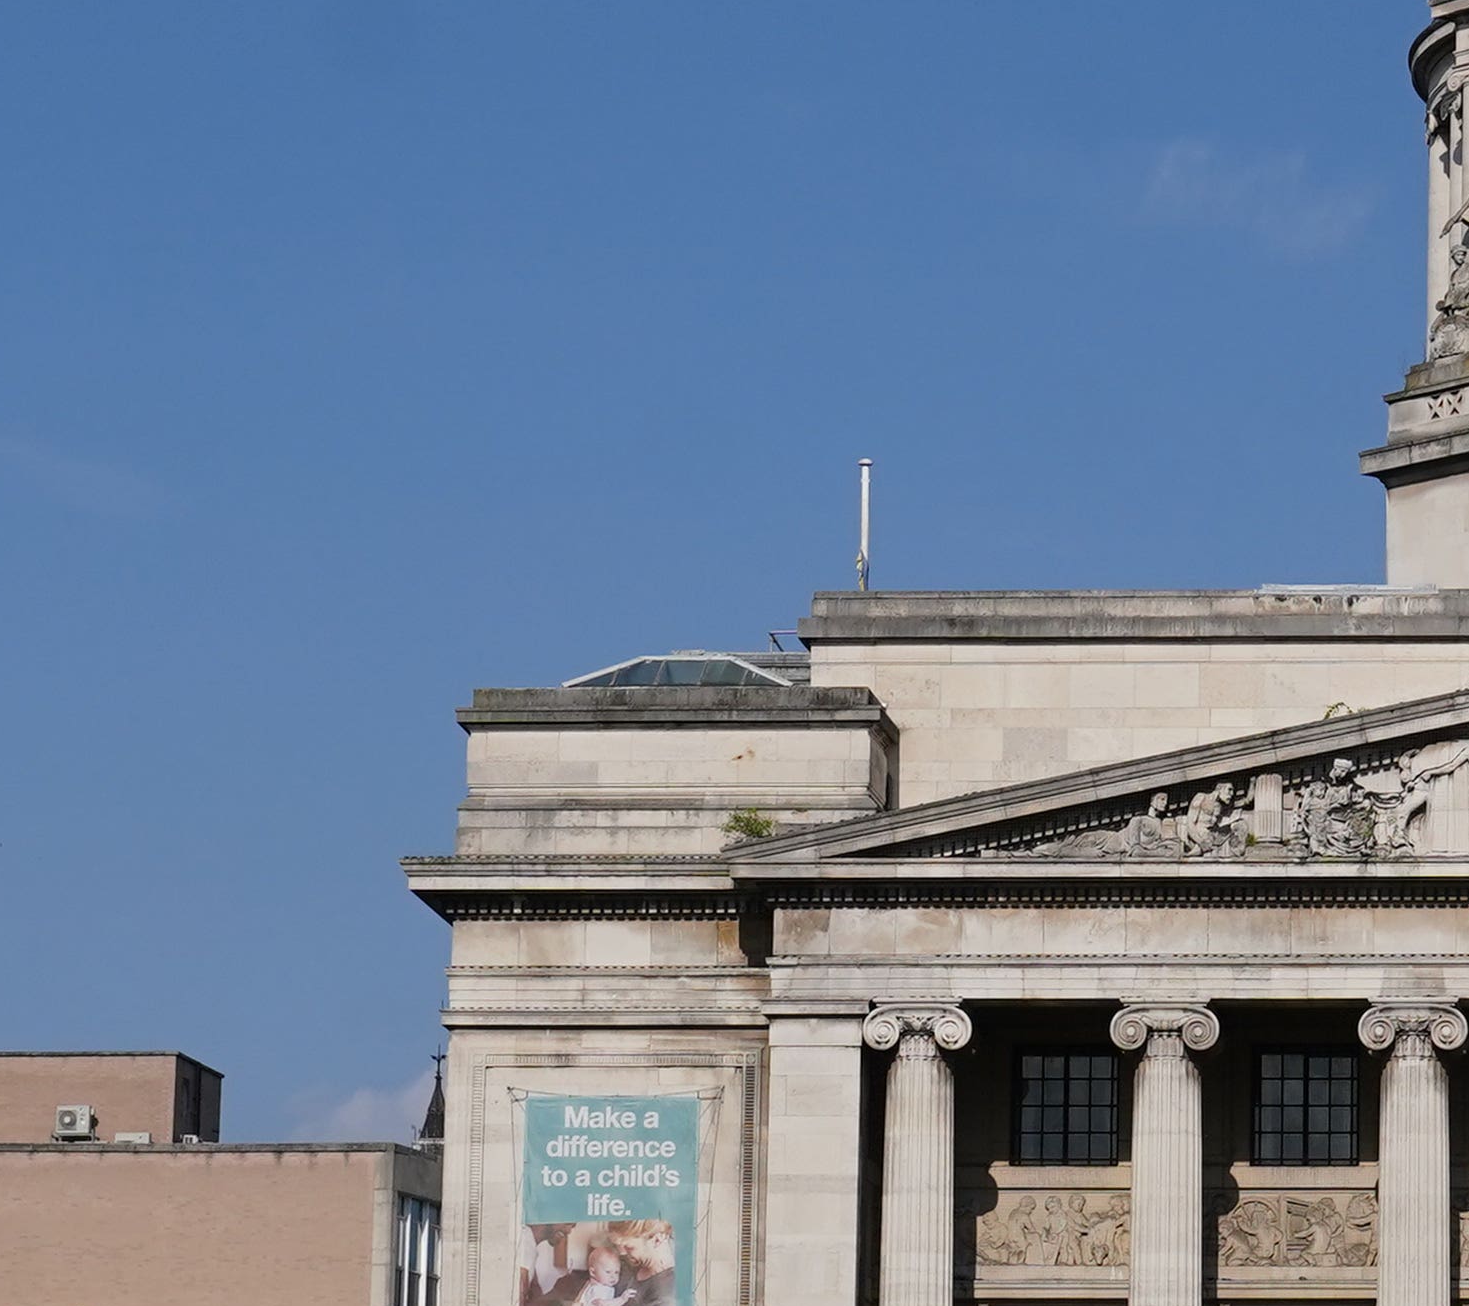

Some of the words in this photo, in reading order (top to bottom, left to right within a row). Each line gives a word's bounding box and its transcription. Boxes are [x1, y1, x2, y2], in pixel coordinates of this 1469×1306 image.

[564, 1106, 636, 1128] Make
[643, 1111, 659, 1128] a
[546, 1135, 676, 1157] difference
[541, 1165, 568, 1187] to
[575, 1170, 590, 1187] a
[597, 1164, 680, 1187] child's
[588, 1193, 631, 1215] life.
